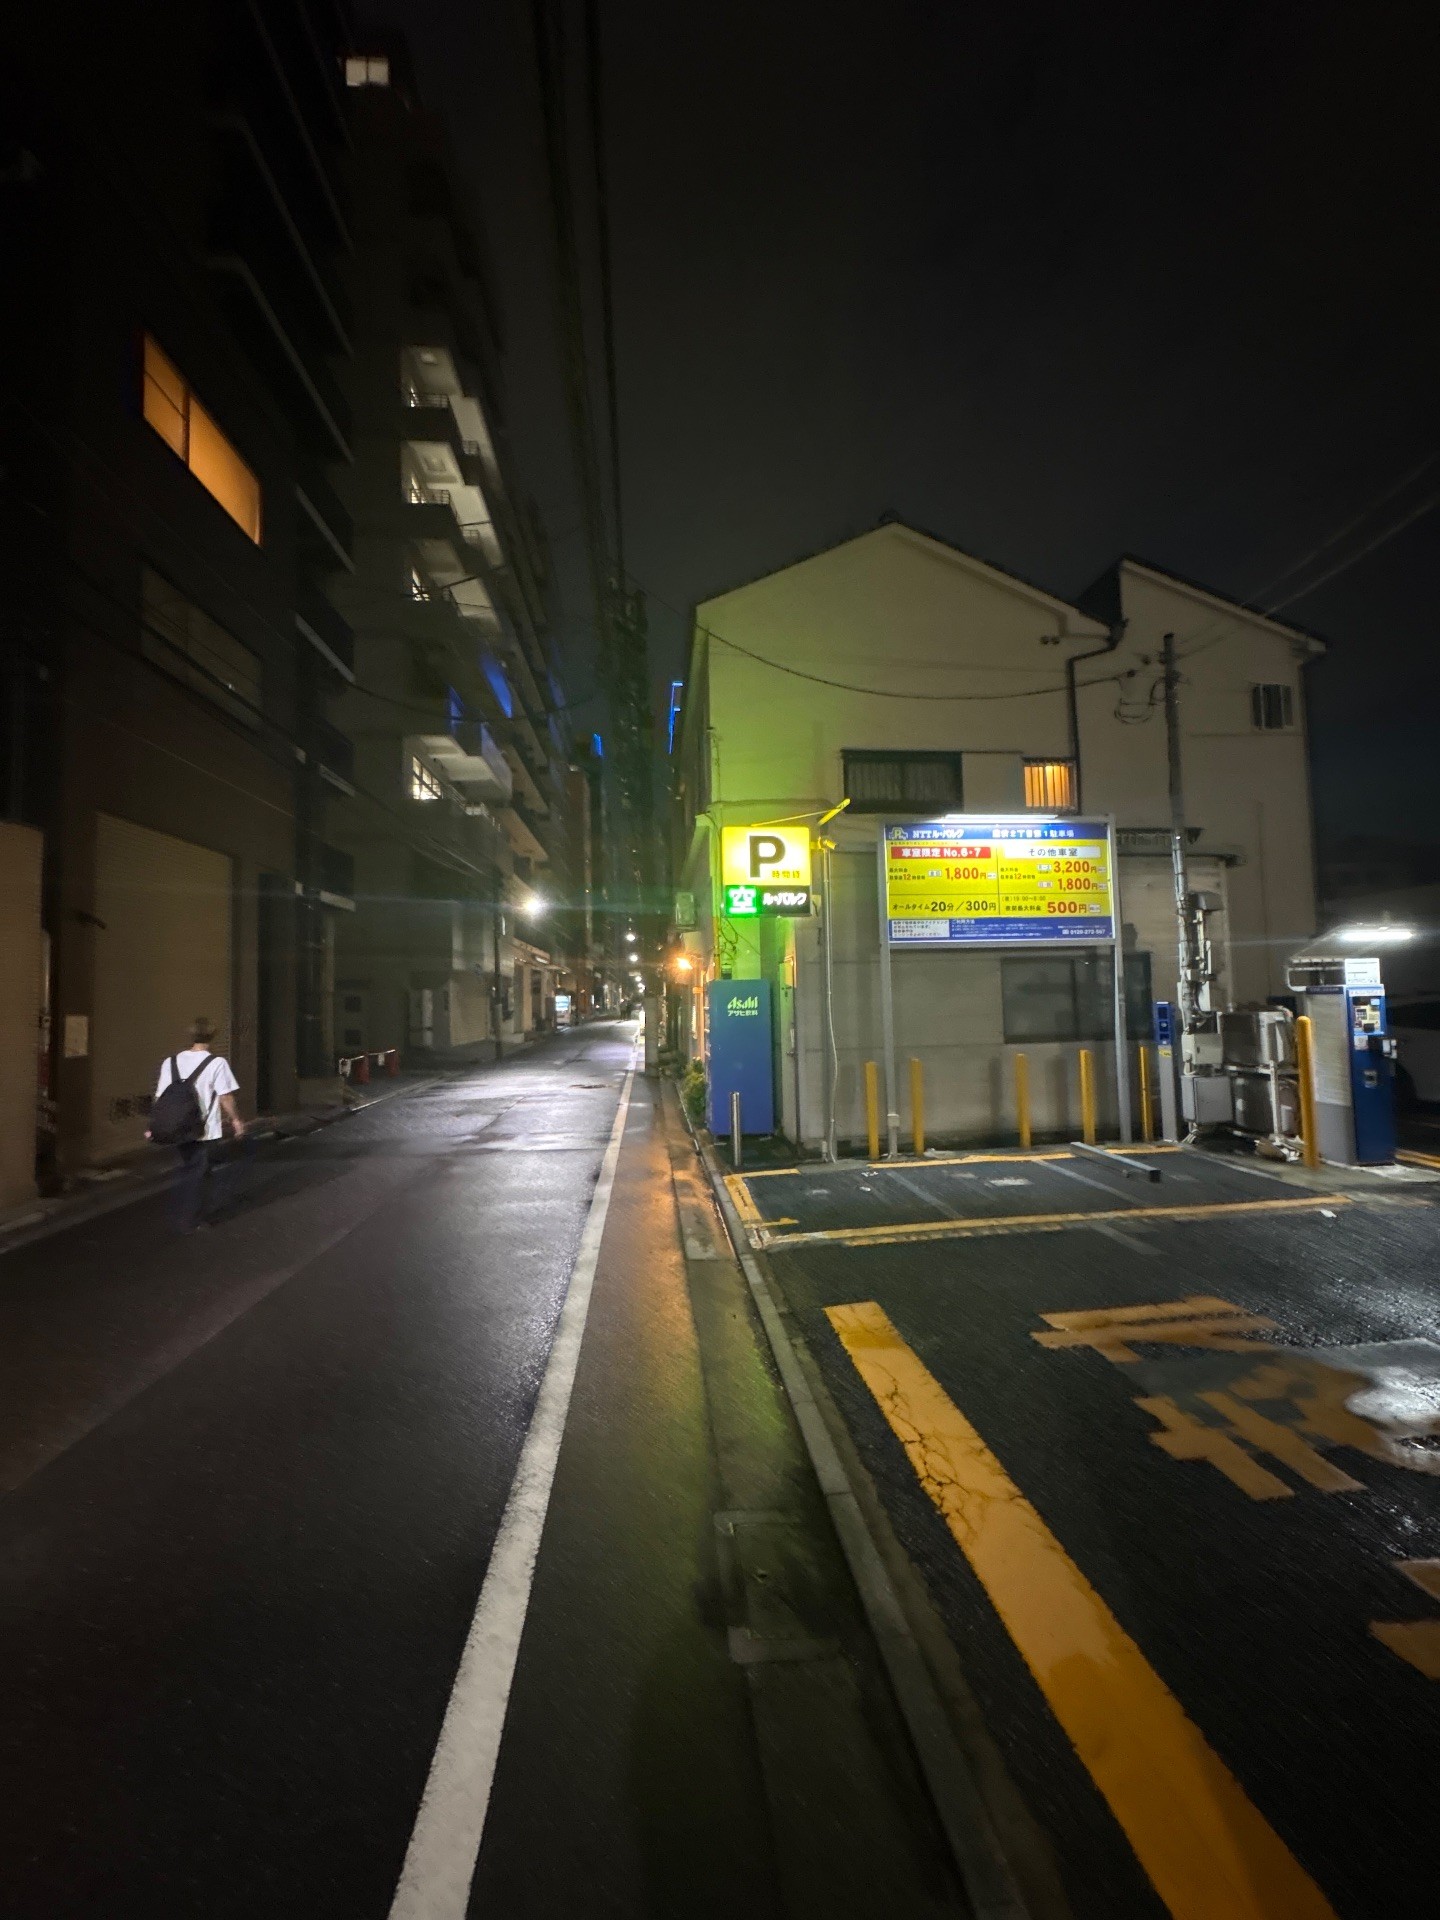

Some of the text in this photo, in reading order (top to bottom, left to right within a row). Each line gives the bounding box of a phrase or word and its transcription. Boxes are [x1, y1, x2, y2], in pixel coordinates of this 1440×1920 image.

[749, 835, 786, 878] P
[1028, 847, 1078, 857] その他車室
[945, 867, 987, 880] 1,800円
[1053, 861, 1097, 874] 3,200円
[1057, 878, 1098, 892] 1,800円
[728, 885, 757, 913] 空
[1047, 901, 1087, 914] 500円
[727, 996, 759, 1009] Asahi
